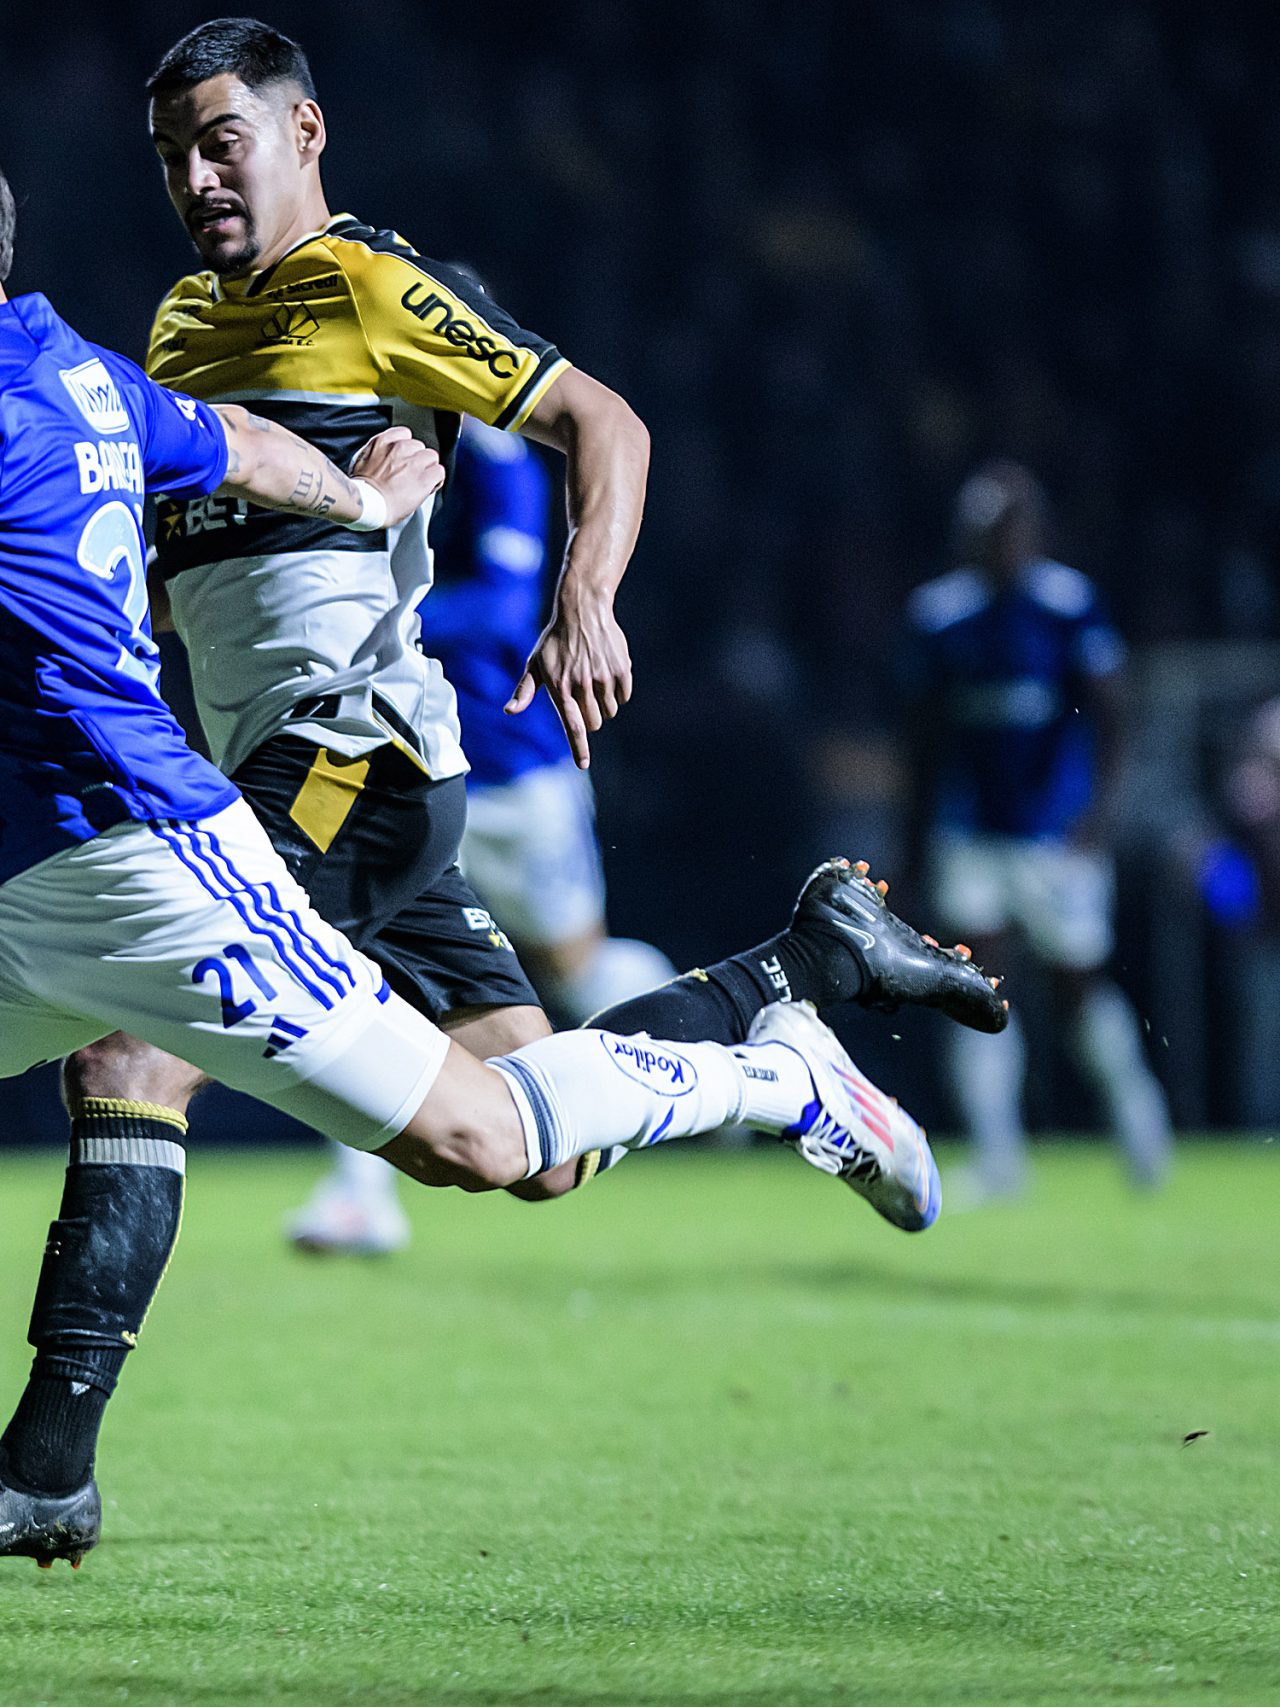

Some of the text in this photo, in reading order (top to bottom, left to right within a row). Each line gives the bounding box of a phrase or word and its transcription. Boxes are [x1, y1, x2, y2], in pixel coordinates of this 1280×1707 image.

[400, 281, 519, 378] unesc
[191, 943, 279, 1029] 21
[614, 1040, 685, 1084] Kodilar
